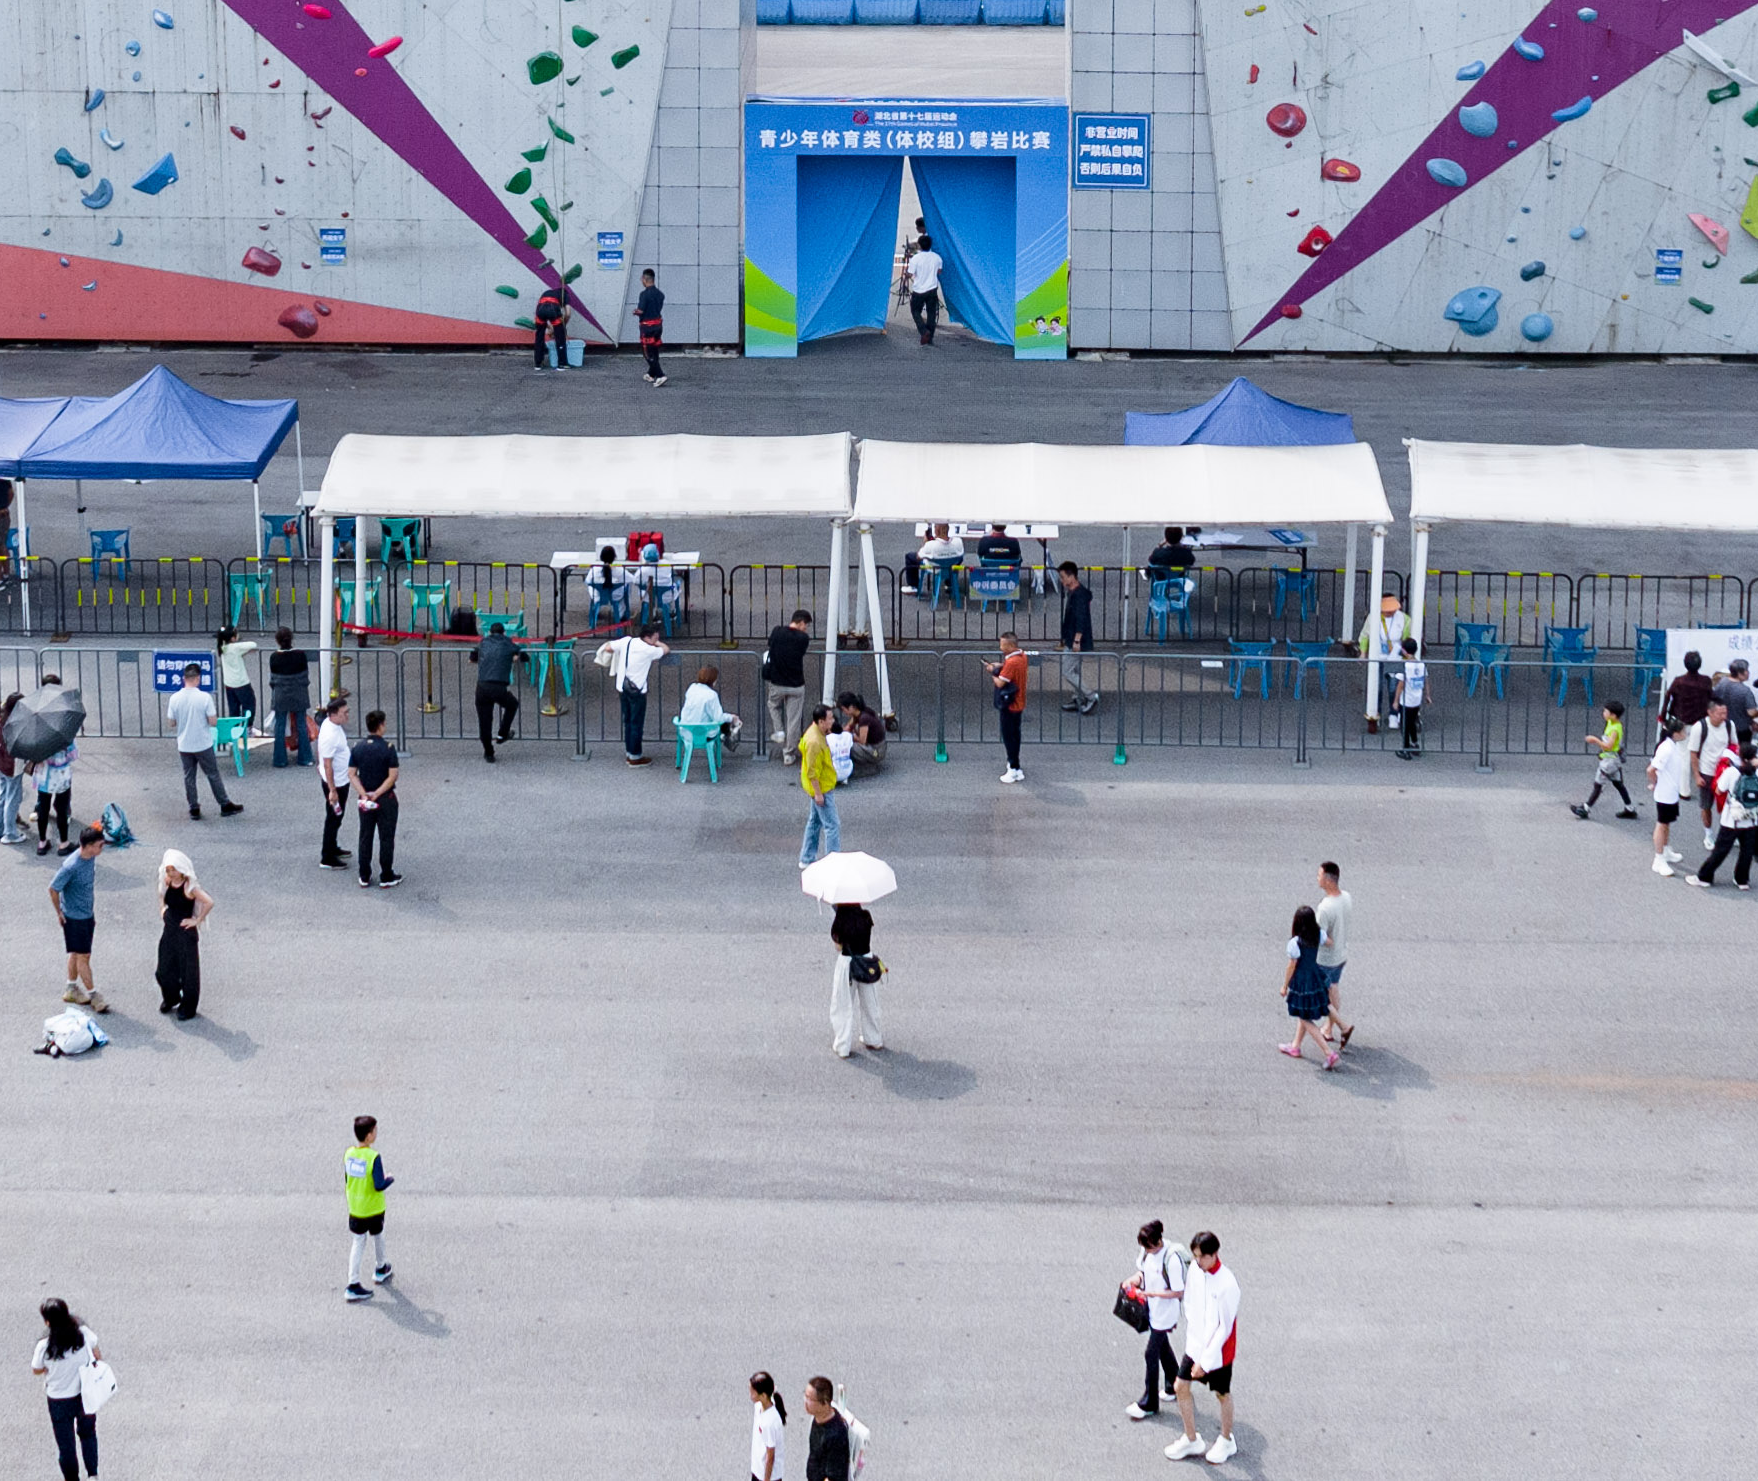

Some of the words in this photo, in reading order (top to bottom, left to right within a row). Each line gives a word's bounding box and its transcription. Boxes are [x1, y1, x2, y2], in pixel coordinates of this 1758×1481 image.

[1085, 126, 1139, 139] 非营业时间
[1079, 162, 1143, 176] 否则后果自负
[157, 660, 211, 671] 请勿穿马
